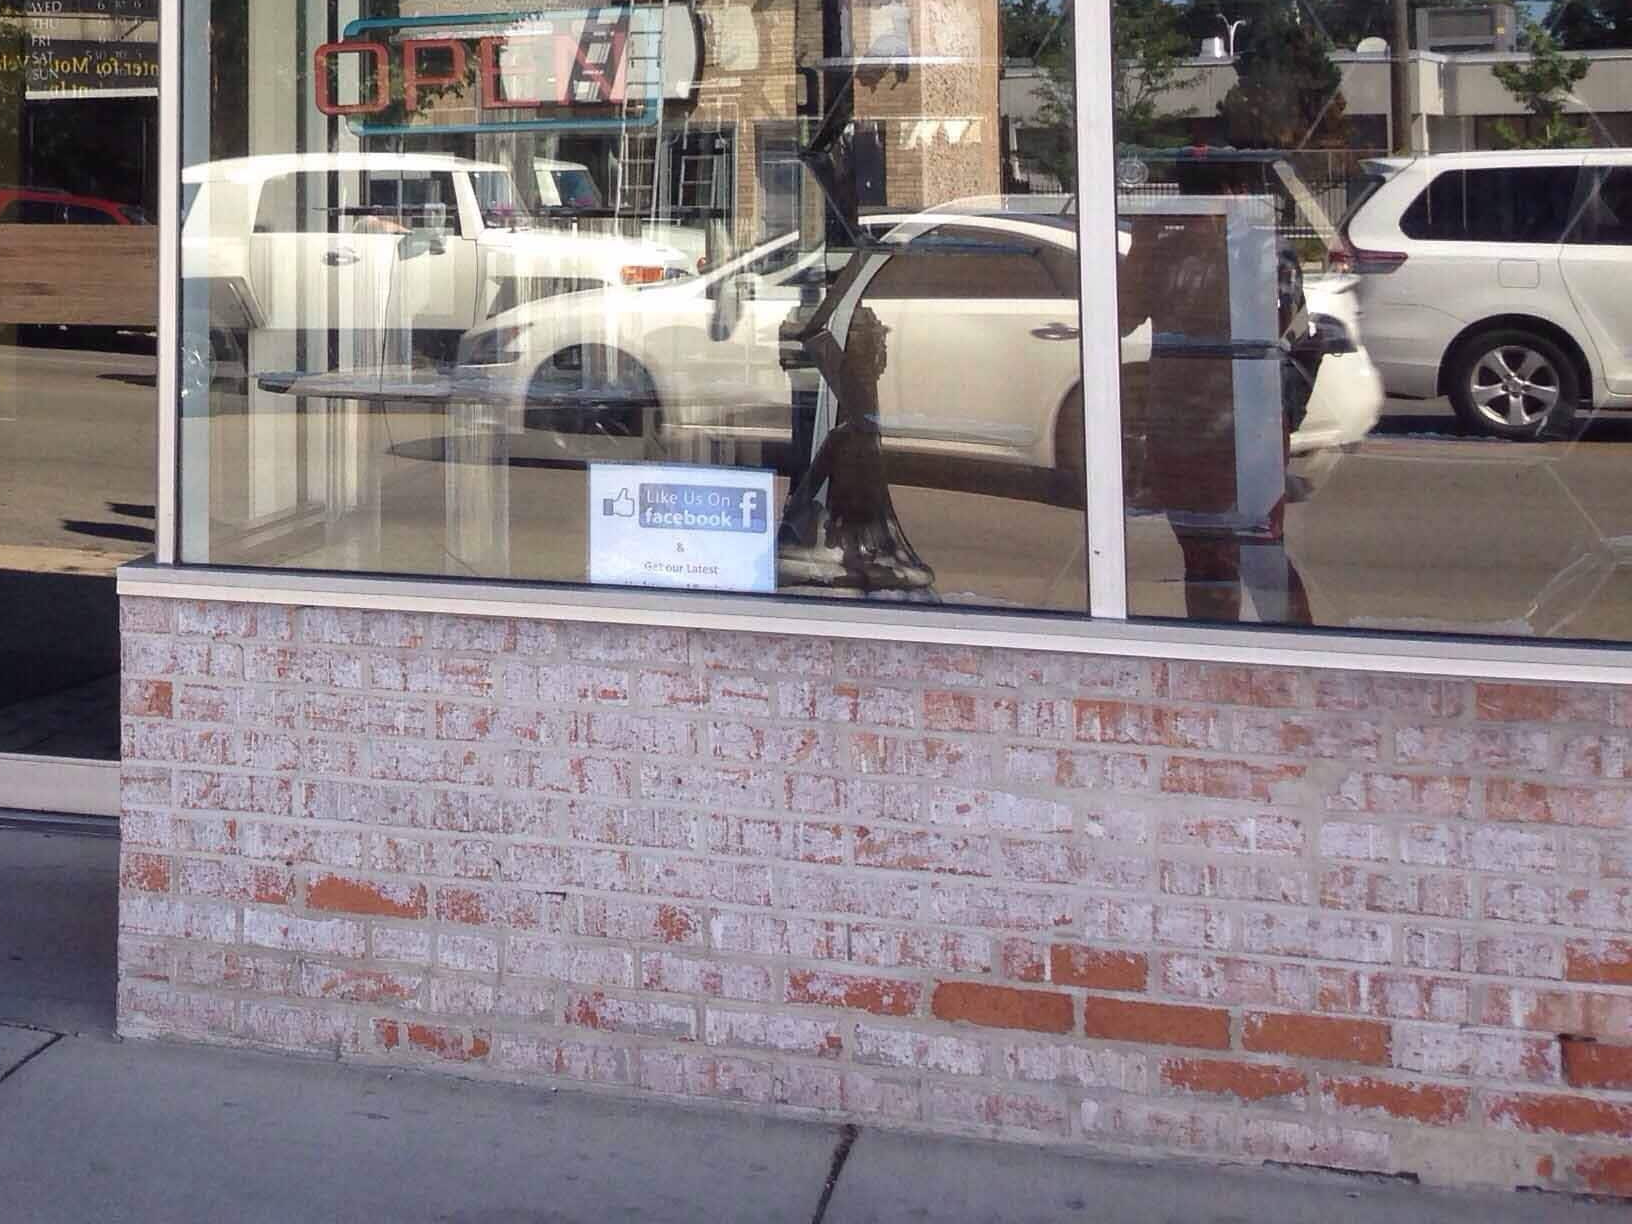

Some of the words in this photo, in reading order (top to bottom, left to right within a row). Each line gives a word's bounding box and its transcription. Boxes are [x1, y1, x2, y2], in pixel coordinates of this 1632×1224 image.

[31, 1, 63, 13] WED
[32, 18, 59, 30] THU
[31, 36, 51, 47] FRI
[32, 51, 54, 65] SAT
[32, 69, 58, 81] SUN
[314, 34, 630, 116] OPEN
[647, 488, 678, 505] Like
[683, 490, 702, 505] Us
[707, 493, 731, 507] On
[644, 508, 732, 528] facebook
[665, 563, 683, 574] our
[686, 563, 720, 575] Latest
